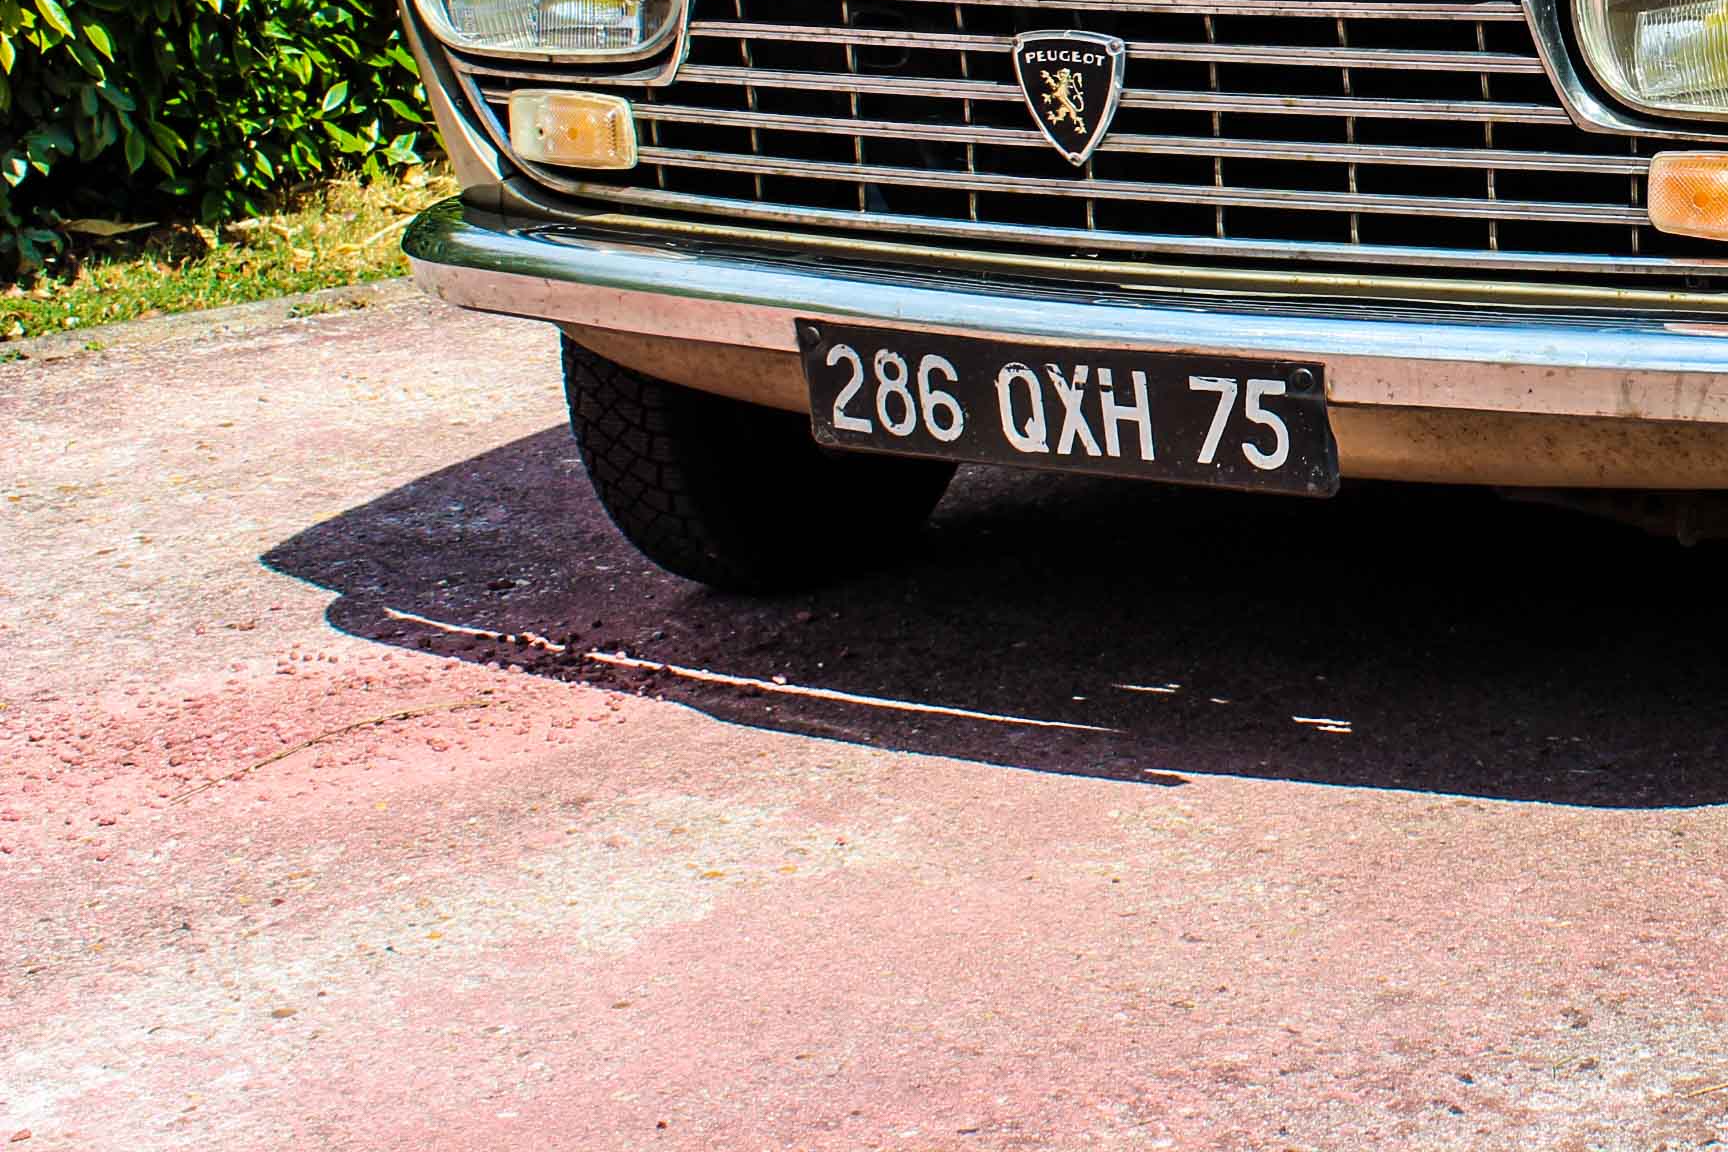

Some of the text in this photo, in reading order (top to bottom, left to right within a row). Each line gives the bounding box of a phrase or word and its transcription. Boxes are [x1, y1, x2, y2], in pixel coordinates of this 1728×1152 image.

[1025, 50, 1106, 67] PEUGEOT
[825, 343, 1290, 471] 286 QXH 75
